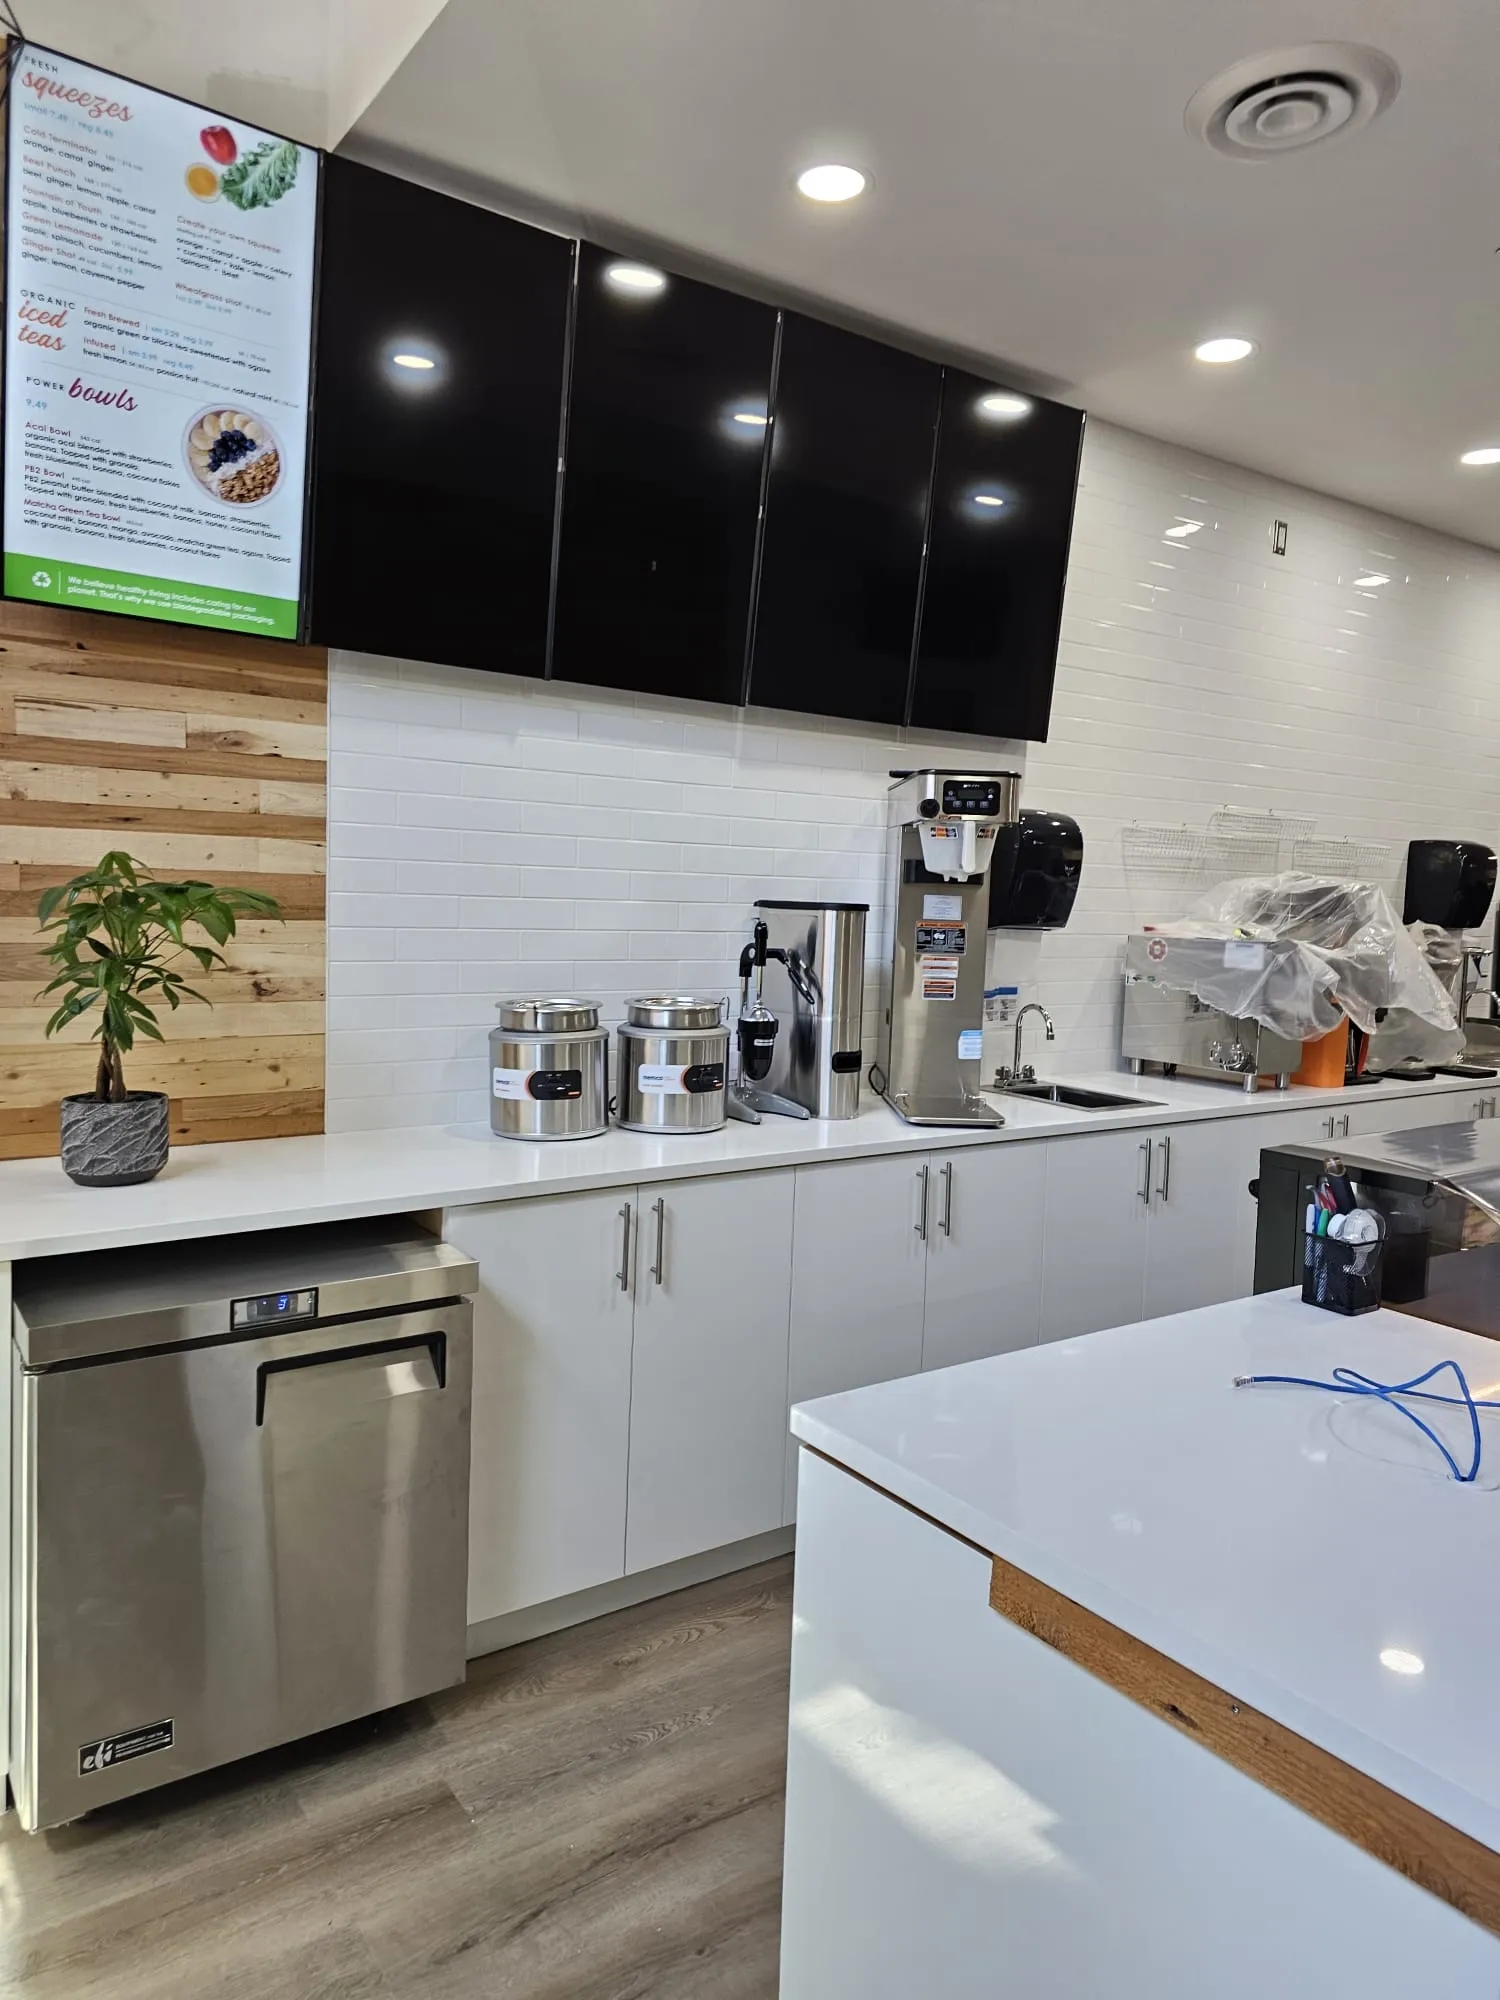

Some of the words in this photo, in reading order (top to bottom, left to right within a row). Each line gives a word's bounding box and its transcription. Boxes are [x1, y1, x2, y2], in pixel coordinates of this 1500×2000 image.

[24, 55, 58, 73] FRESH
[22, 72, 133, 121] squeezes
[23, 124, 45, 139] Cold
[48, 132, 97, 156] Terminator
[46, 162, 75, 178] Punch
[87, 158, 114, 175] ginger
[22, 184, 63, 204] Fountain
[77, 201, 102, 216] Youth
[46, 174, 74, 191] ginger,
[106, 193, 131, 209] apple,
[133, 202, 156, 215] carrot
[22, 196, 49, 213] apple,
[52, 205, 96, 225] blueberries
[110, 223, 157, 243] strawberries
[22, 211, 50, 226] Green
[54, 220, 102, 242] Lemonade
[176, 214, 205, 230] Create
[21, 237, 53, 254] Ginger
[56, 247, 76, 259] Shot
[137, 257, 162, 270] lemon
[80, 268, 115, 283] cayenne
[117, 278, 144, 291] pepper
[174, 282, 222, 303] Wheatgrass
[20, 289, 76, 310] ORGANIC
[18, 300, 67, 328] iced
[84, 307, 105, 319] Fresh
[108, 313, 139, 328] Brewed
[18, 325, 65, 351] teas
[83, 336, 115, 351] Infused
[83, 318, 114, 334] organic
[117, 328, 140, 340] green
[151, 336, 172, 347] black
[189, 346, 229, 362] sweetened
[232, 357, 245, 366] with
[248, 363, 270, 374] agave
[83, 348, 102, 359] fresh
[103, 353, 127, 365] lemon
[156, 366, 182, 380] passion
[26, 376, 64, 391] POWER
[68, 378, 138, 411] bowls
[26, 398, 46, 410] 9.49
[25, 421, 46, 432] Acai
[49, 426, 70, 437] Bowl
[25, 430, 55, 444] organic
[57, 437, 74, 447] acai
[77, 442, 109, 455] blended
[112, 449, 126, 458] with
[60, 448, 89, 461] Topped
[92, 454, 106, 463] with
[24, 450, 43, 460] fresh
[126, 471, 157, 483] coconut
[159, 477, 180, 488] flakes
[43, 467, 64, 478] Bowl
[40, 478, 68, 490] peanut
[71, 484, 93, 494] butter
[96, 488, 128, 501] blended
[130, 495, 145, 504] with
[147, 498, 177, 510] coconut
[23, 508, 56, 520] coconut
[24, 484, 54, 497] Topped
[56, 490, 72, 499] with
[109, 500, 126, 509] fresh
[230, 524, 259, 535] coconut
[24, 497, 55, 510] Matcha
[58, 504, 83, 515] Green
[102, 512, 120, 522] Bowl
[23, 517, 38, 526] with
[108, 532, 125, 541] fresh
[169, 543, 198, 554] coconut
[67, 585, 97, 598] planet.
[99, 590, 122, 600] That's
[171, 601, 231, 618] biodegradable
[83, 578, 115, 589] believe
[116, 583, 147, 596] healthy
[148, 588, 170, 600] living
[171, 592, 205, 604] includes
[83, 1742, 113, 1769] efi
